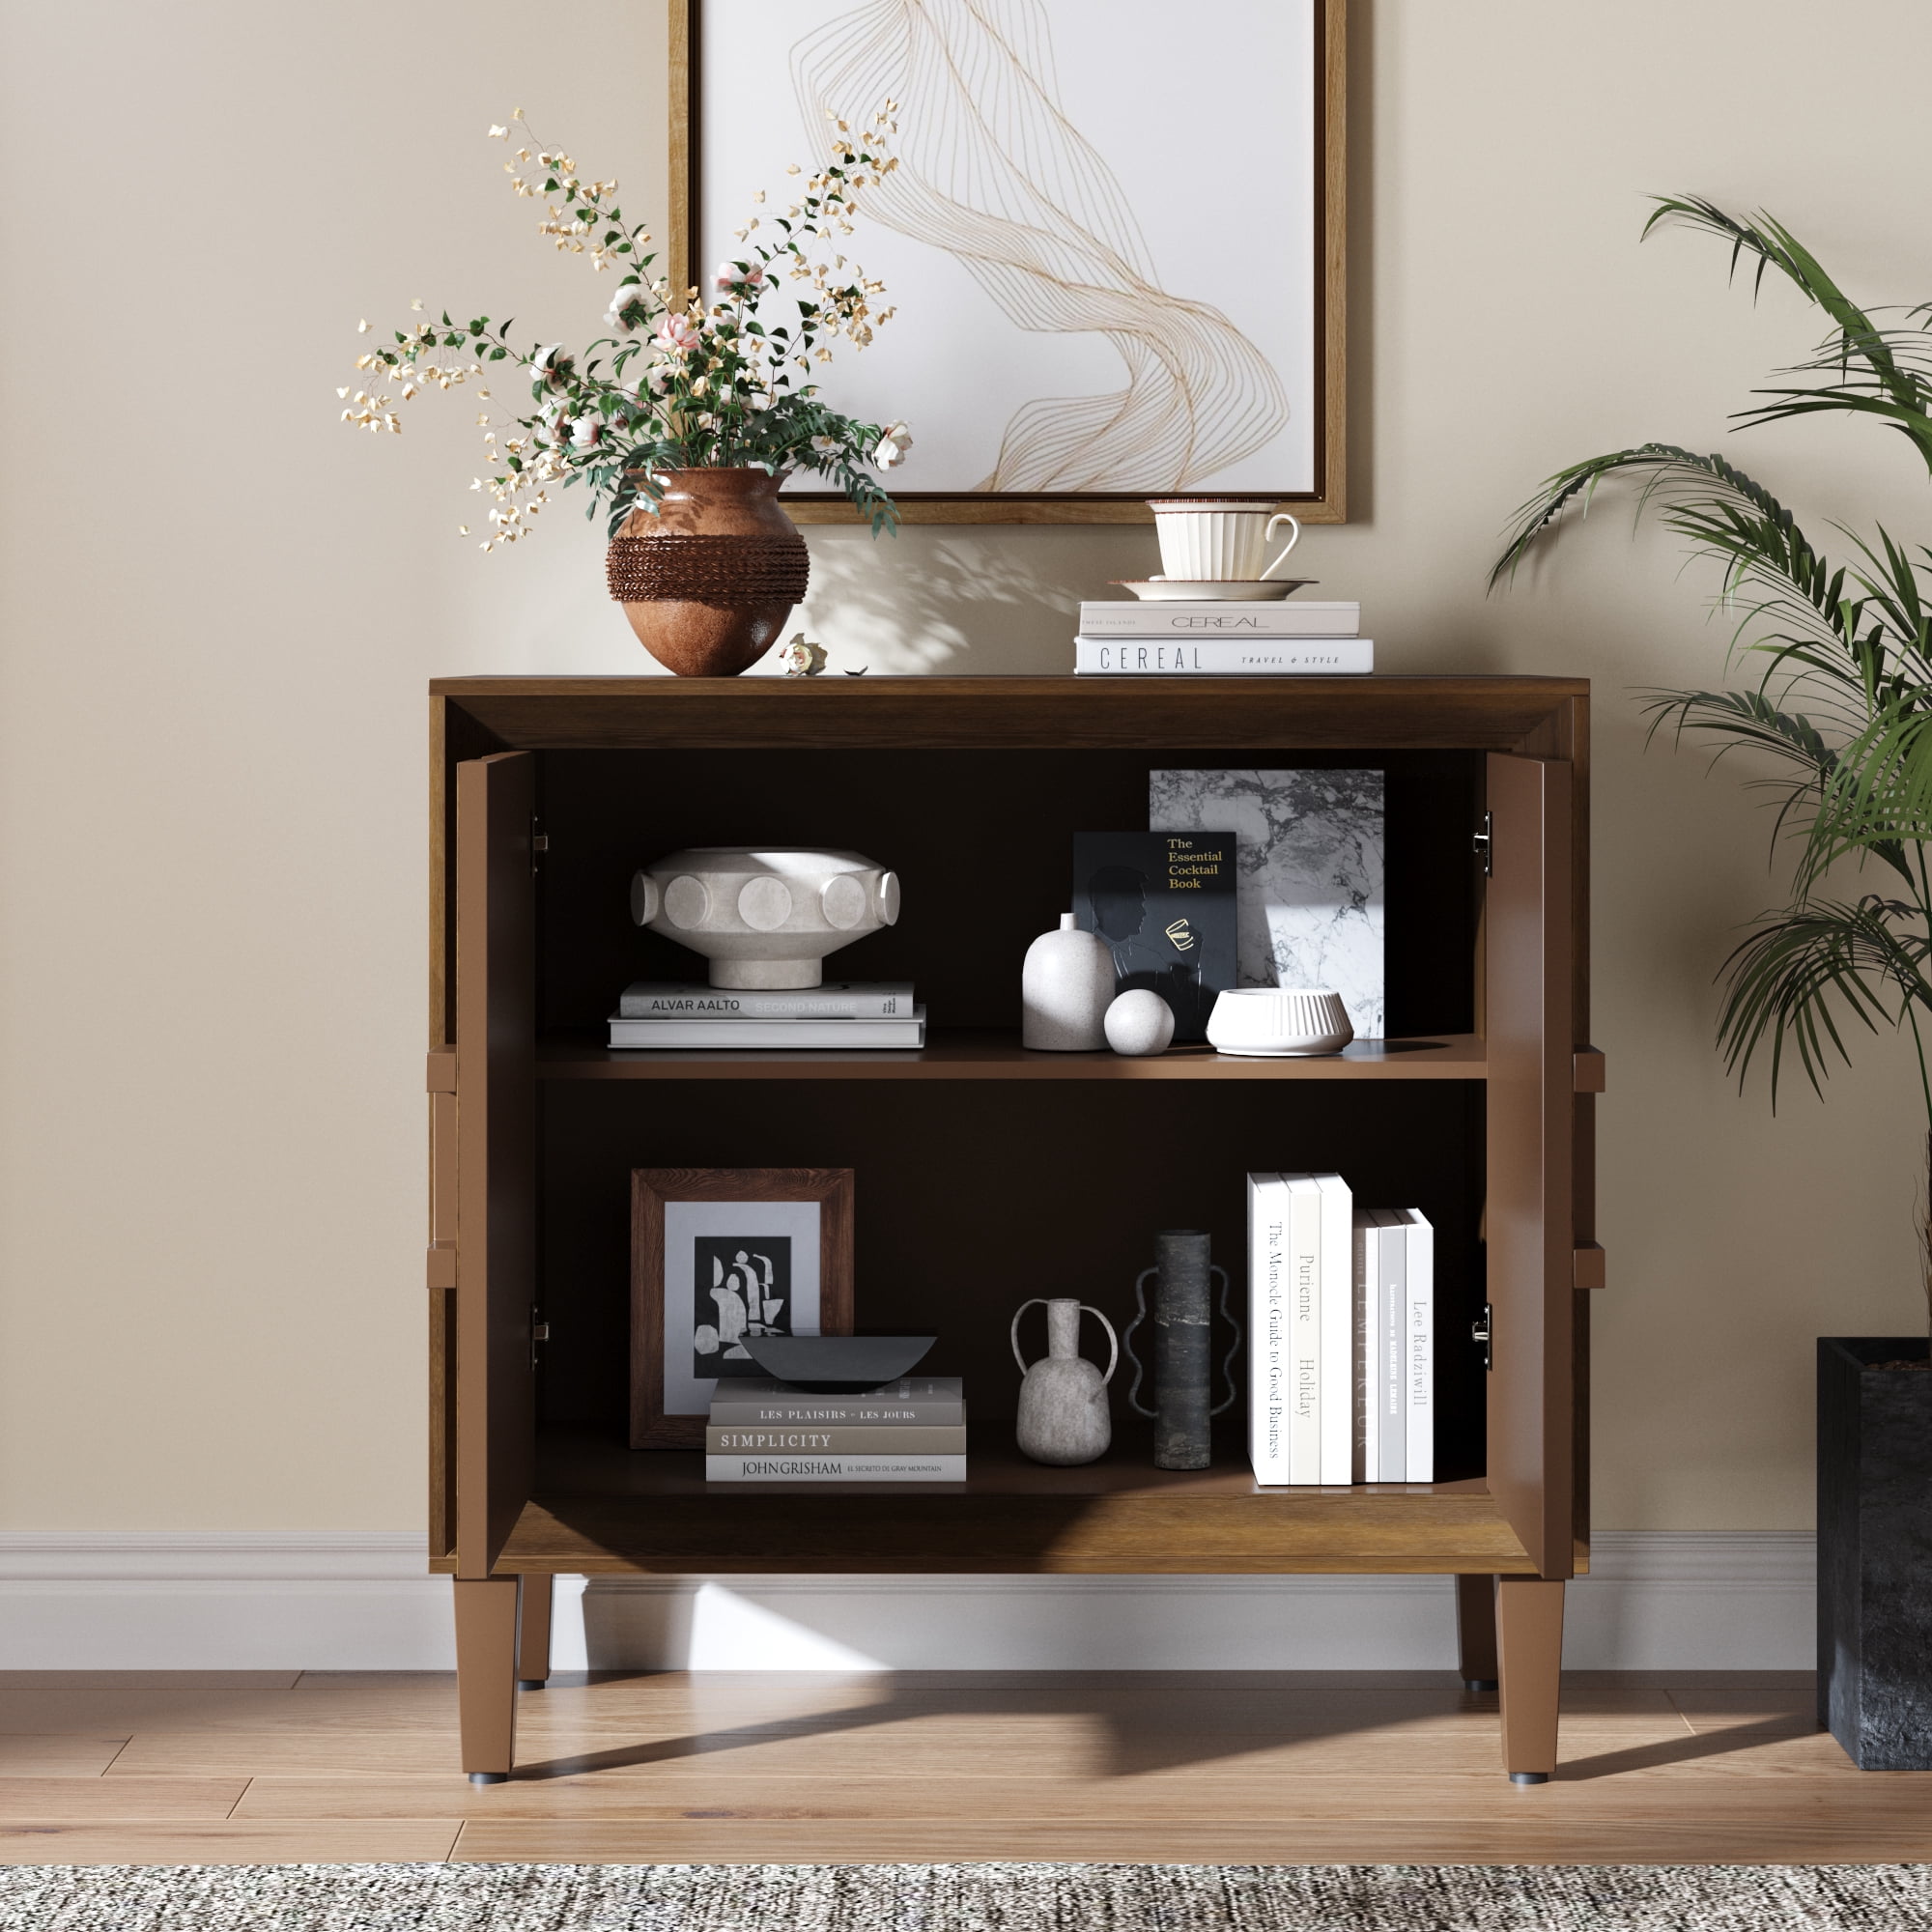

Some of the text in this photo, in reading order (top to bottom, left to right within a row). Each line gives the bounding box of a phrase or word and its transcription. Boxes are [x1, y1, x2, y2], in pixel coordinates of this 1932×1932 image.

[1171, 616, 1270, 628] CEREAL
[1099, 647, 1203, 669] CEREAL
[1167, 838, 1193, 849] The
[1168, 851, 1223, 863] Essential
[1168, 865, 1219, 875] Cocktail
[1169, 878, 1202, 889] Book
[650, 1000, 740, 1010] ALVAR AALTO
[754, 1002, 858, 1013] SECOND NATURE
[1269, 1221, 1283, 1460] The Monocle Guide to Good Business
[1294, 1255, 1316, 1419] Purienne Holiday
[1413, 1301, 1428, 1406] Lee Radziwill
[760, 1409, 782, 1420] LES
[788, 1409, 847, 1420] PLAISIRS
[860, 1410, 879, 1420] LES
[883, 1410, 916, 1420] JOURS
[721, 1435, 832, 1448] SIMPLICITY
